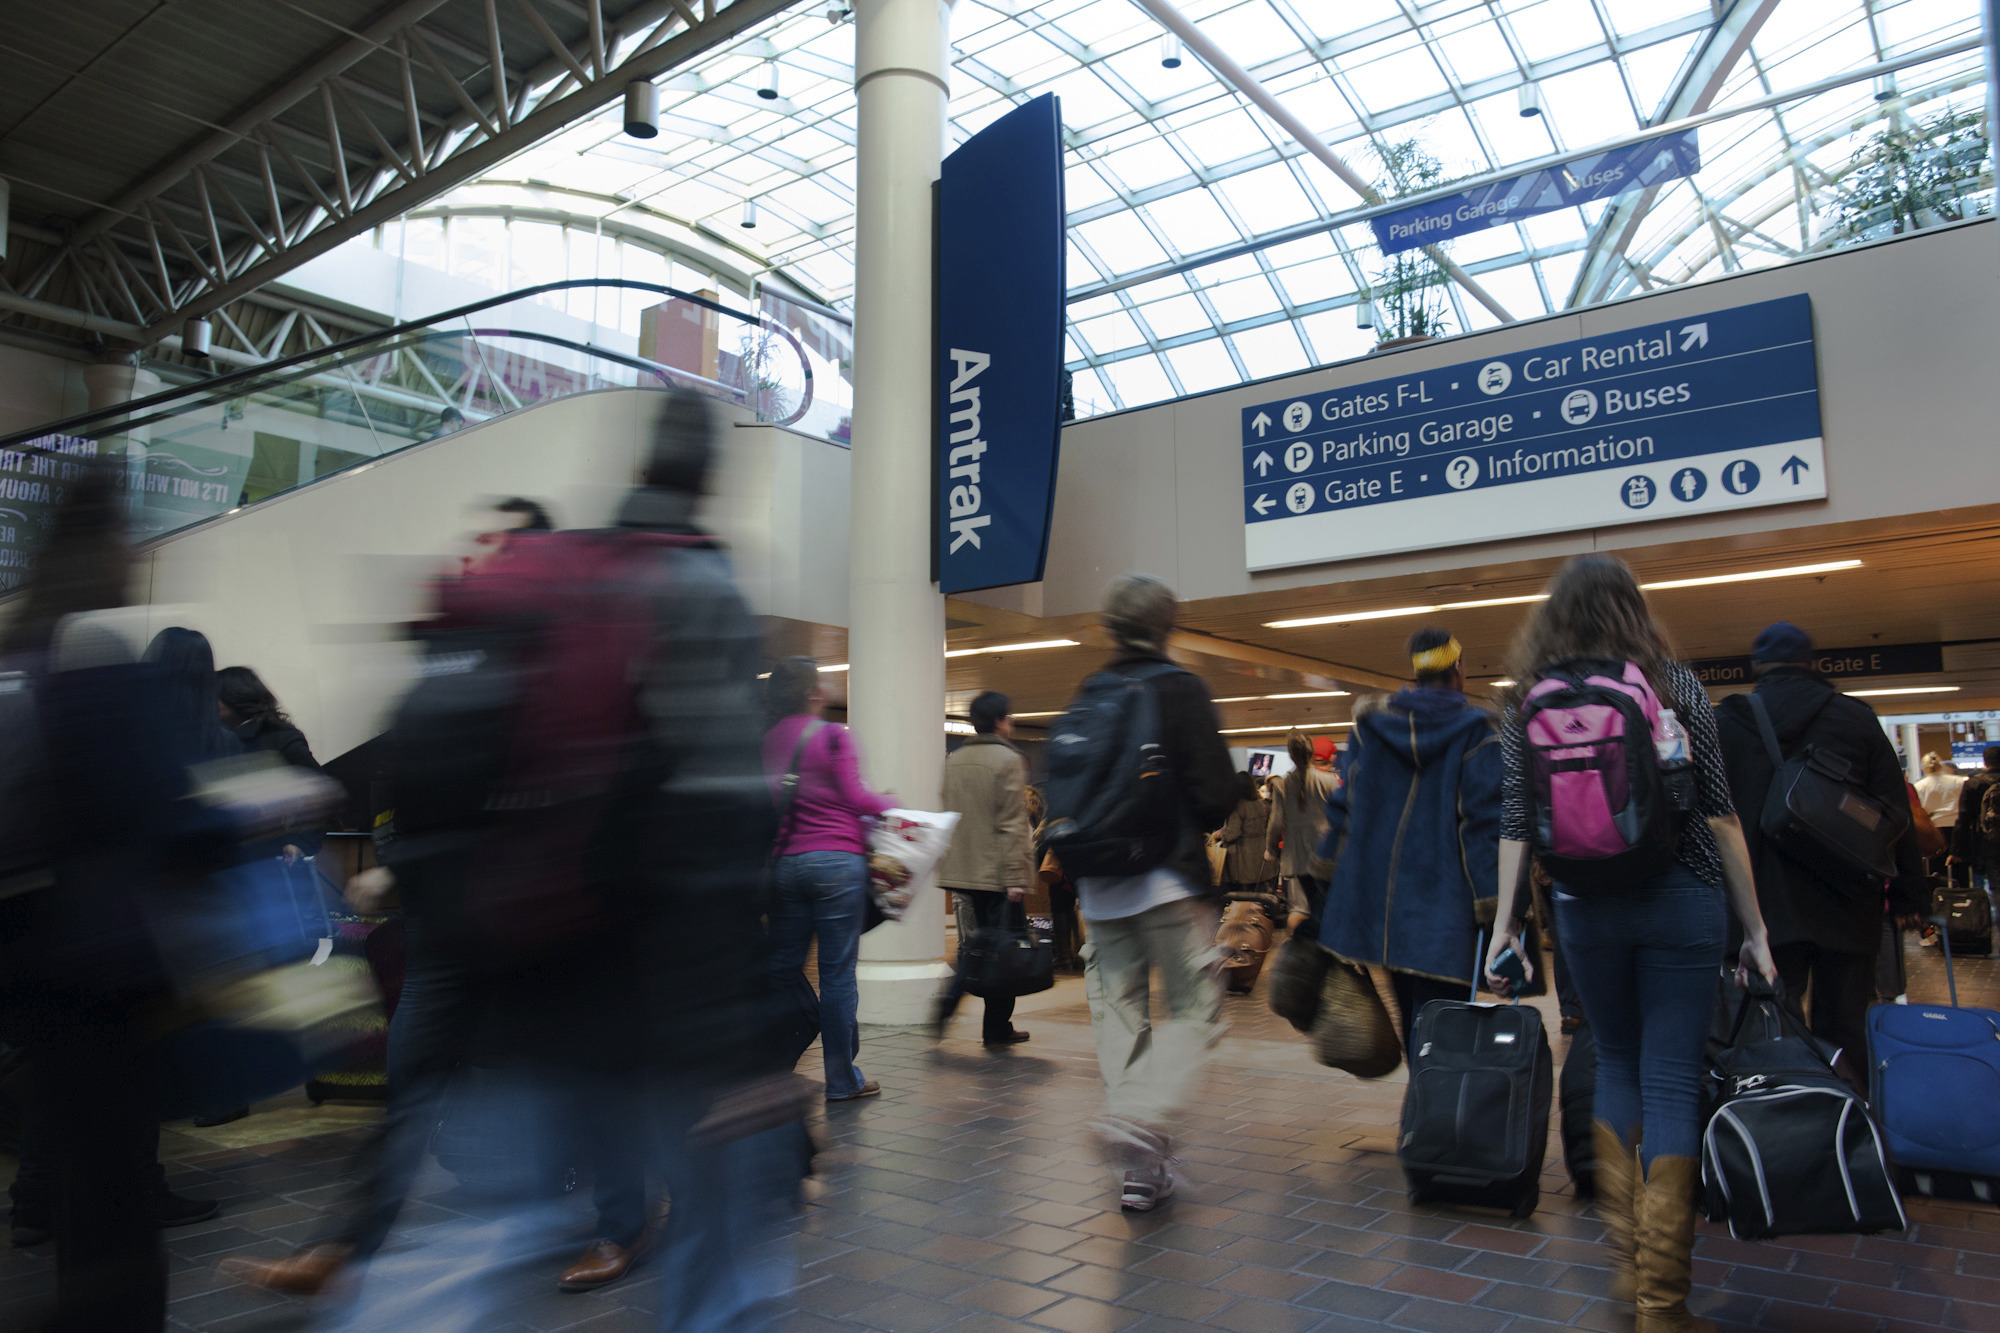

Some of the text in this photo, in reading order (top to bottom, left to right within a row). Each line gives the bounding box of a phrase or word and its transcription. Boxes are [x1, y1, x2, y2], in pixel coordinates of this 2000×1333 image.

[1389, 211, 1453, 239] Parking
[1456, 194, 1519, 223] Garage
[1523, 330, 1673, 382] Car Rental
[1321, 380, 1433, 421] Gates F-L
[1322, 432, 1410, 463] Parking
[1419, 413, 1514, 445] Garage
[1605, 382, 1691, 415] Buses
[949, 348, 991, 555] Amtrak
[1324, 435, 1655, 504] Gate E Information
[1817, 653, 1882, 674] Gate E
